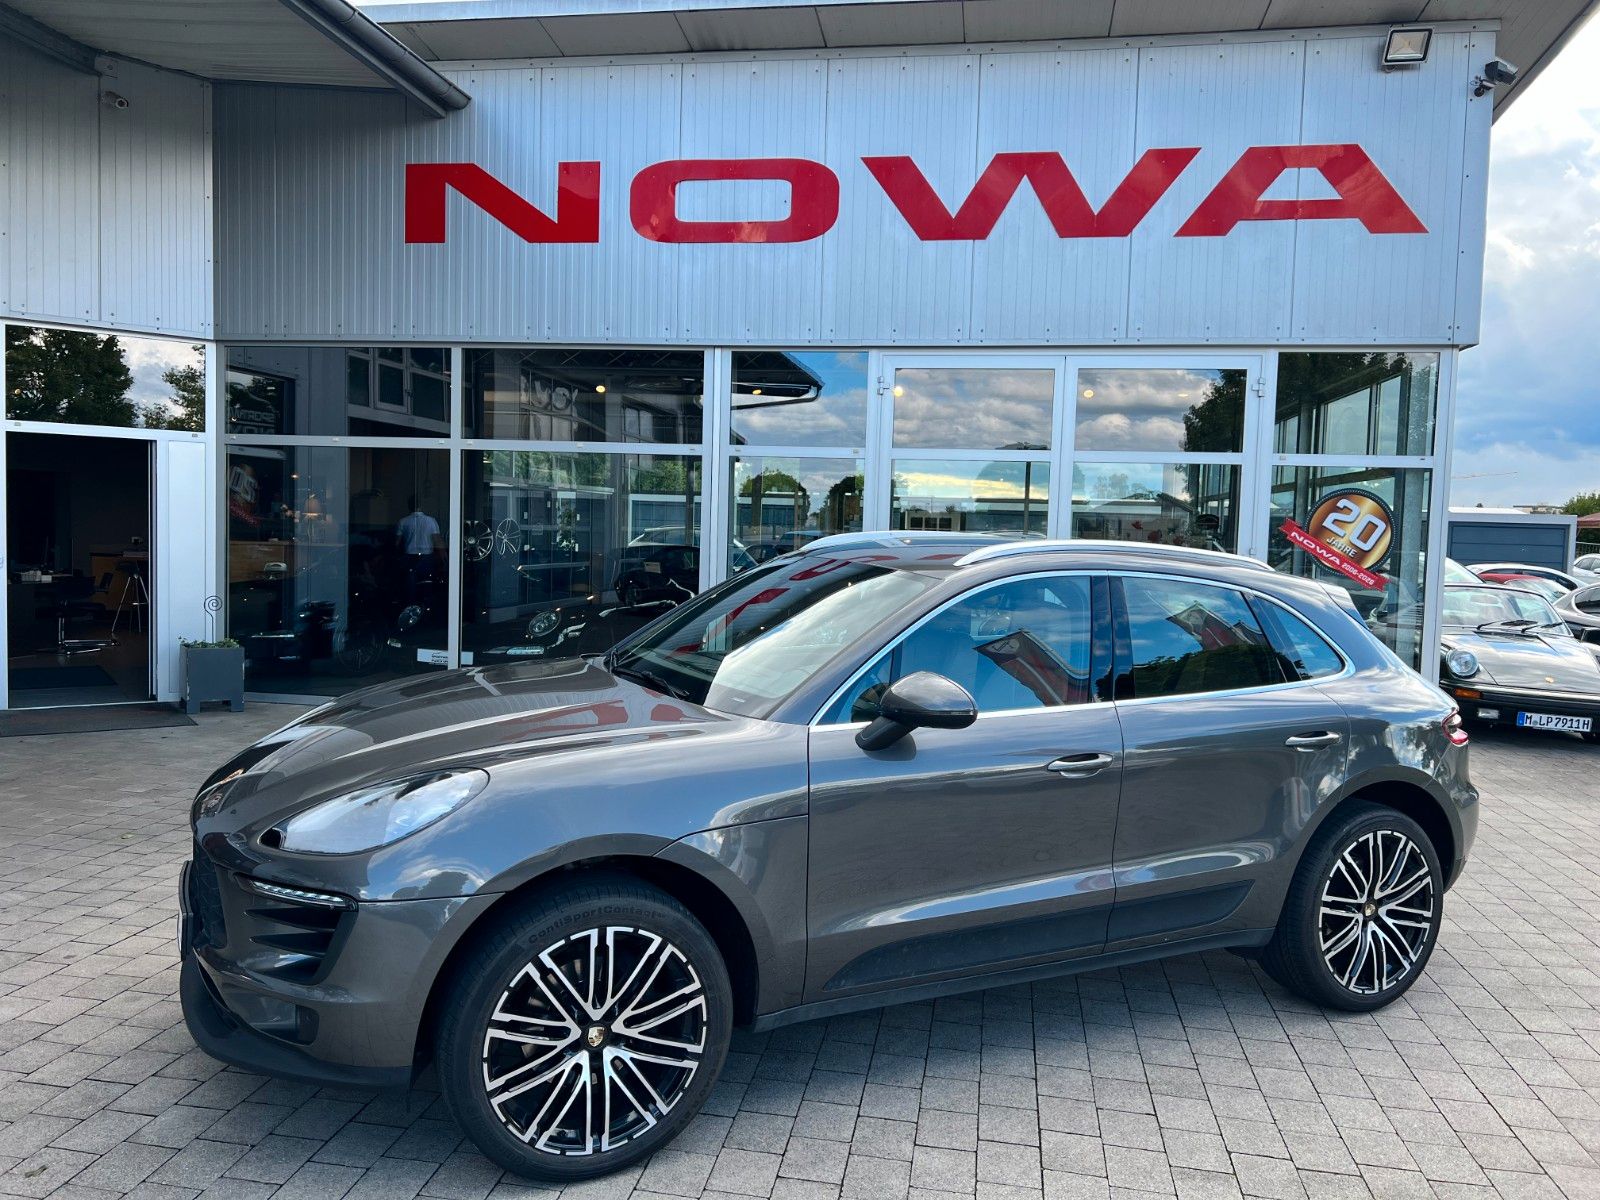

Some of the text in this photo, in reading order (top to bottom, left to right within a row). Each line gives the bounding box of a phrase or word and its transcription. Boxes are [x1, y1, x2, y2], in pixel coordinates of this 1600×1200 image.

[405, 144, 1429, 243] NOWA
[1322, 498, 1386, 552] 20
[1291, 532, 1340, 565] NOWA
[1326, 537, 1357, 558] JAHRE
